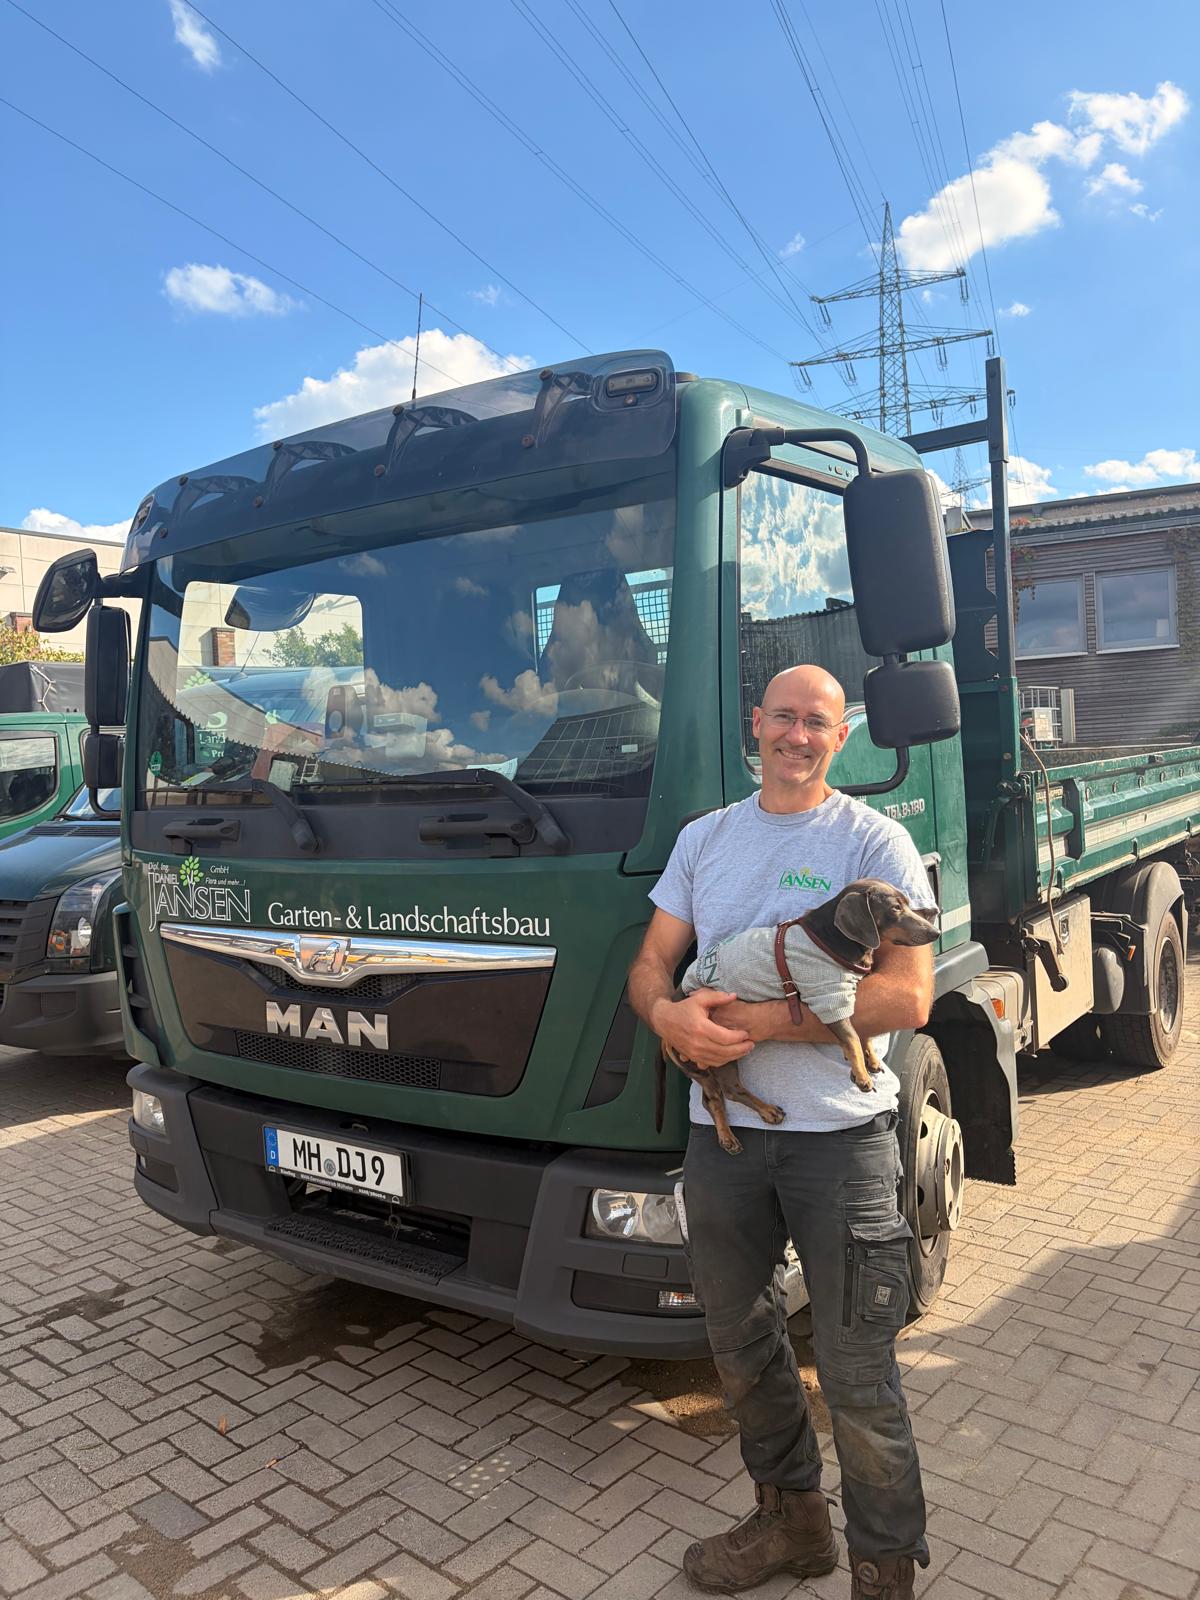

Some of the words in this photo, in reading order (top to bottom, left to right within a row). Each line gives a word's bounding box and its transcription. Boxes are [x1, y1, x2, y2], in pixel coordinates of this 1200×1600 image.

[155, 873, 180, 885] DANIEL
[210, 864, 230, 874] GmbH
[205, 877, 217, 885] Flora
[217, 878, 227, 886] und
[148, 872, 251, 932] JANSEN
[267, 902, 341, 928] Garten-
[346, 905, 362, 930] &
[368, 905, 550, 937] Landschaftsbau
[266, 1001, 389, 1050] MAN
[270, 1150, 276, 1160] D
[292, 1137, 322, 1173] MH
